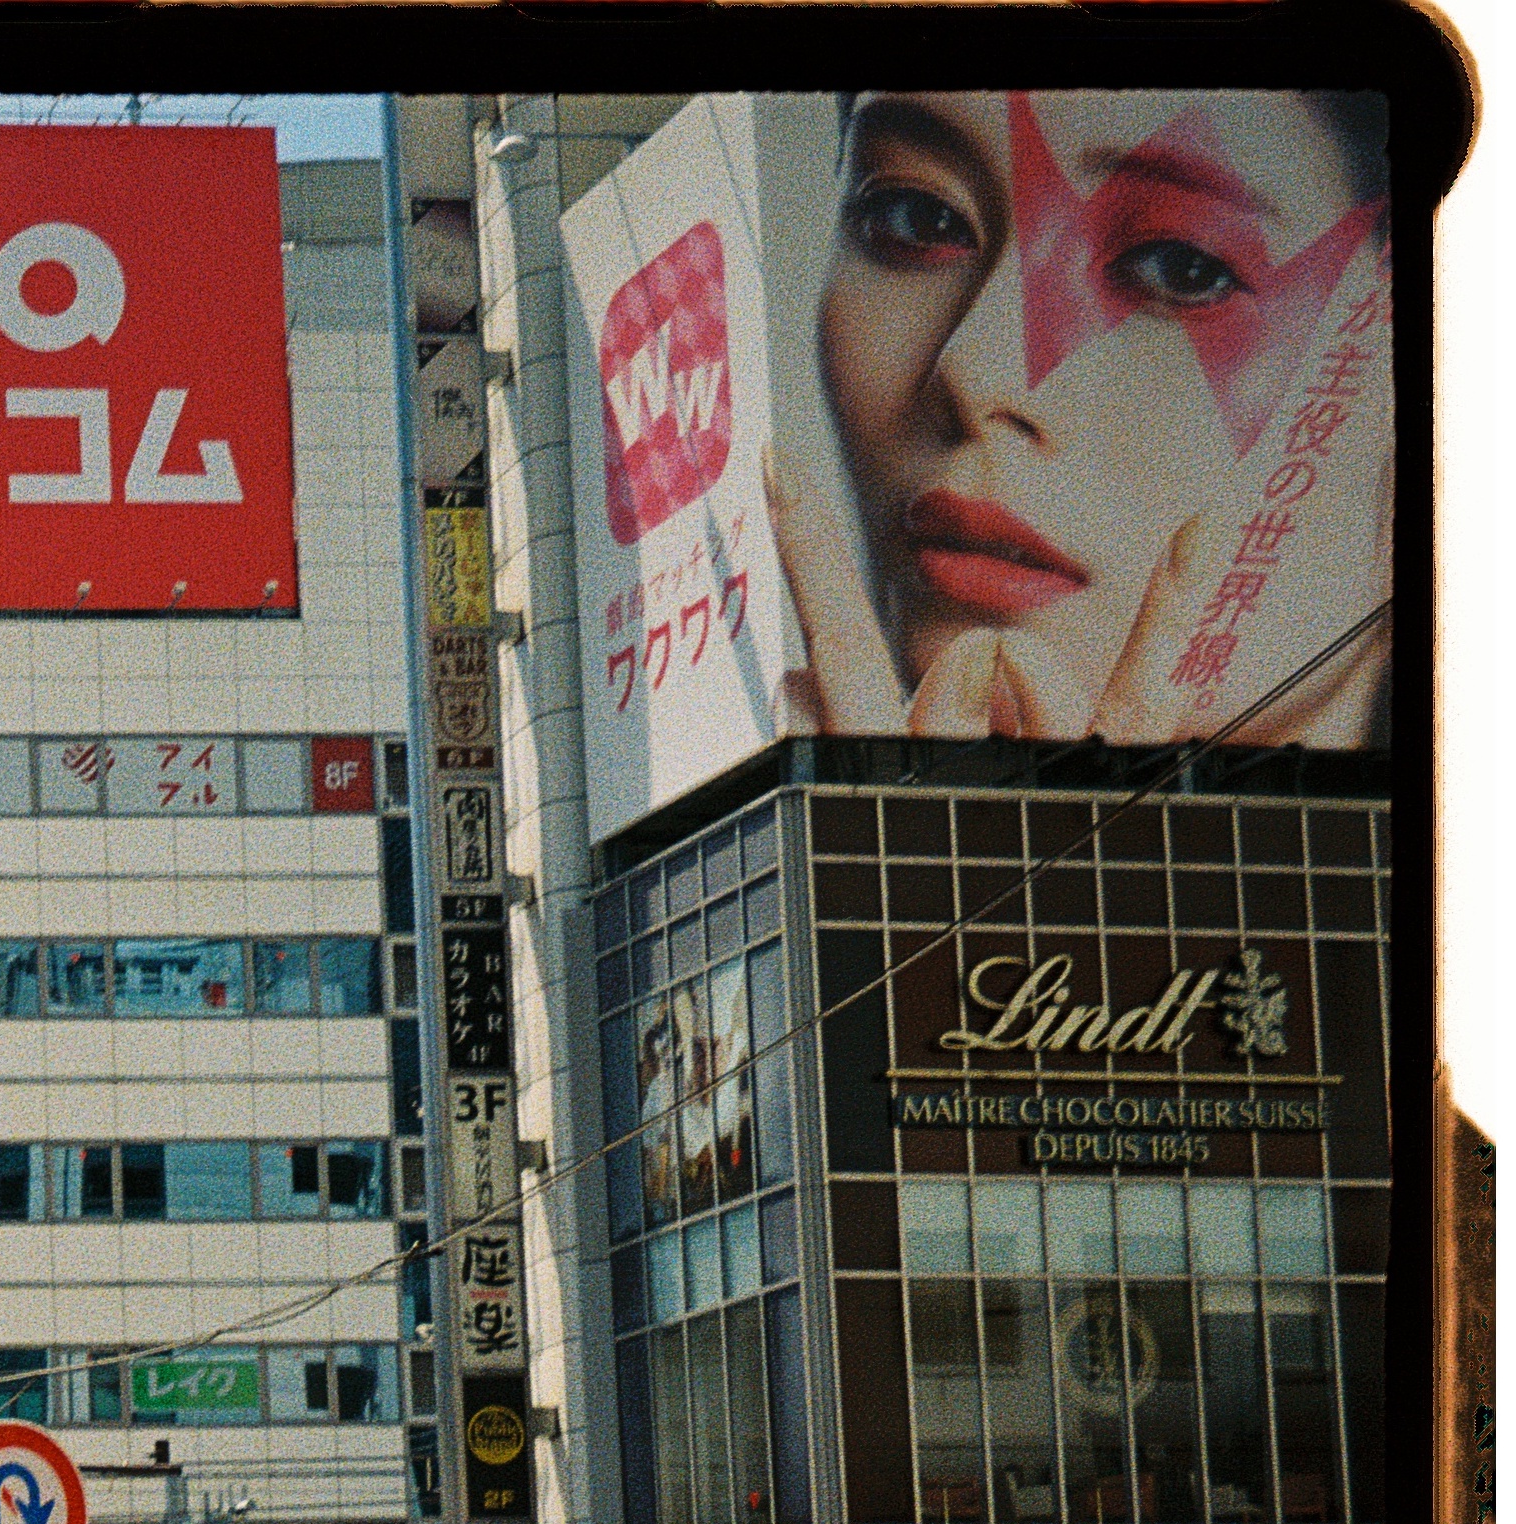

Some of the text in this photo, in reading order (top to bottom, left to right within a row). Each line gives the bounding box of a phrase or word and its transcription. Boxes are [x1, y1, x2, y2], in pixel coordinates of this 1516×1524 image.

[607, 568, 747, 712] ワクワク
[324, 762, 360, 790] 8F
[448, 939, 472, 1044] カラオケ
[484, 952, 504, 1034] BAR
[939, 954, 1219, 1053] Lindt
[455, 1083, 507, 1122] 3F
[1020, 1099, 1231, 1126] CHOCOLATIER
[1239, 1101, 1330, 1129] SUISSE
[1034, 1133, 1209, 1162] DEPUIS 1845
[147, 1368, 236, 1399] レイク
